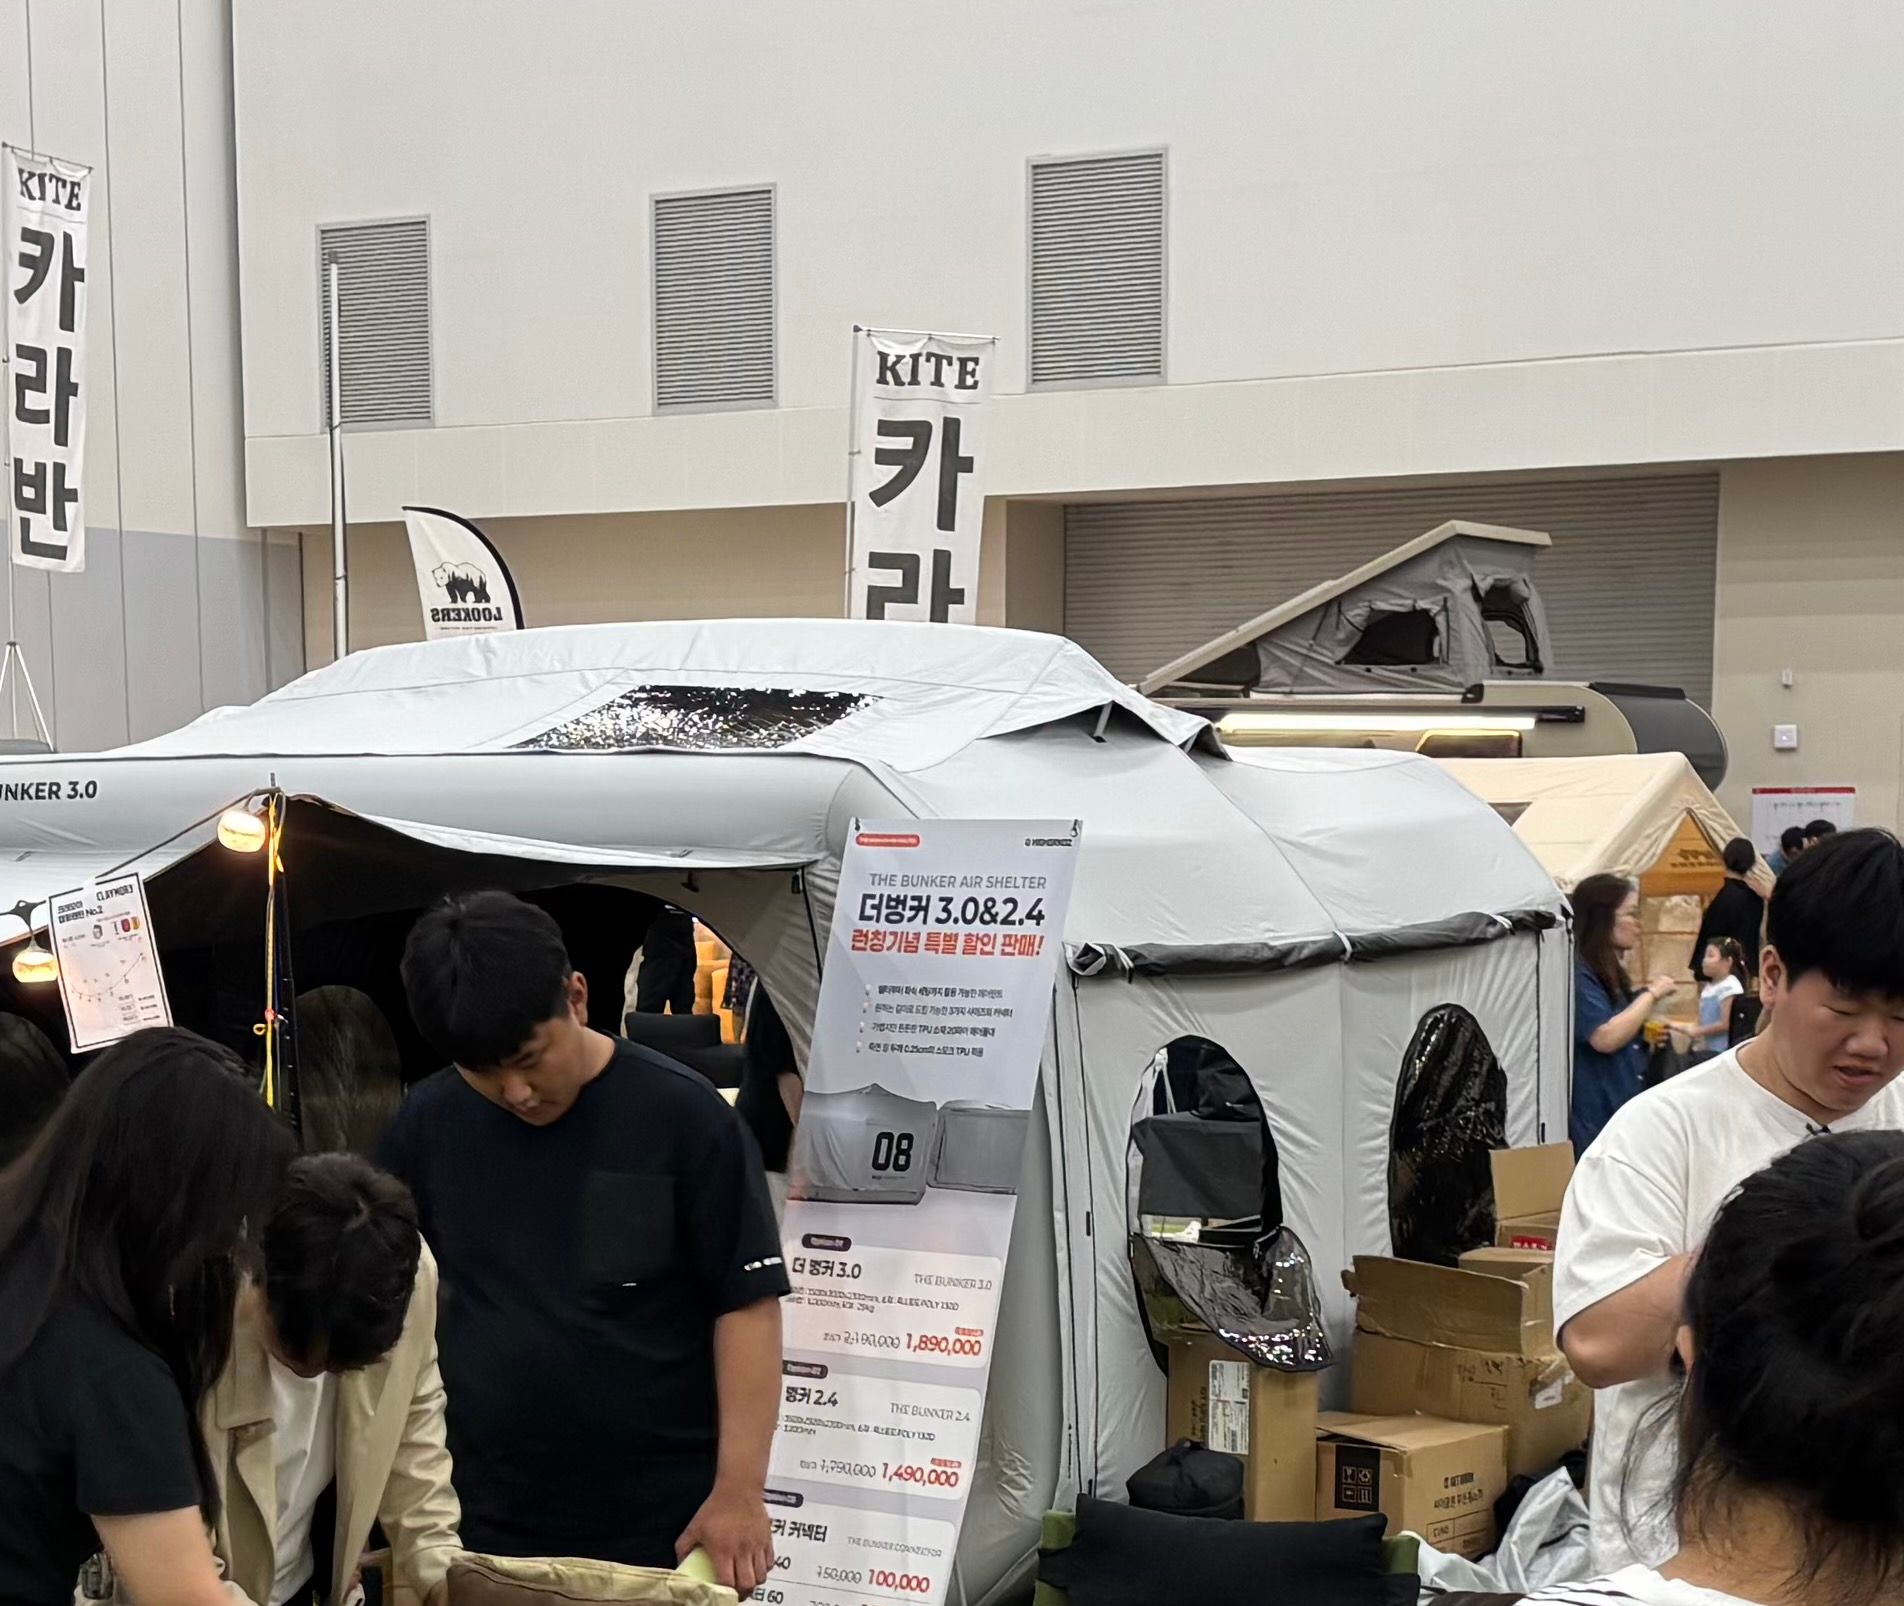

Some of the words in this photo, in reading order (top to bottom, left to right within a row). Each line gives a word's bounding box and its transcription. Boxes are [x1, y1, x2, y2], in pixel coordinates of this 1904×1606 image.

[16, 166, 82, 213] KITE
[875, 351, 980, 391] KITE
[12, 225, 86, 561] 카라반
[66, 780, 98, 799] 3.0
[869, 873, 897, 888] THE
[900, 874, 956, 888] BUNKER
[960, 875, 983, 889] AIR
[985, 875, 1047, 889] SHELTER
[857, 893, 932, 925] 더벙커
[934, 896, 1045, 926] 3.0&2.4
[851, 929, 920, 953] 런칭기념
[924, 931, 959, 955] 특별
[961, 932, 997, 956] 할인
[1000, 934, 1044, 957] 판매!
[871, 1131, 914, 1172] 08
[792, 1258, 805, 1274] 더
[809, 1259, 835, 1278] 벙커
[837, 1263, 862, 1279] 3.0
[934, 1276, 976, 1288] BUNKER
[977, 1279, 993, 1290] 3.0
[906, 1333, 981, 1356] 1,890,000
[785, 1386, 810, 1404] 벙커
[813, 1389, 839, 1407] 2.4
[882, 1463, 959, 1488] 1,490,000
[788, 1521, 827, 1543] 커넥터
[868, 1569, 930, 1593] 100,000
[767, 1591, 784, 1605] 60
